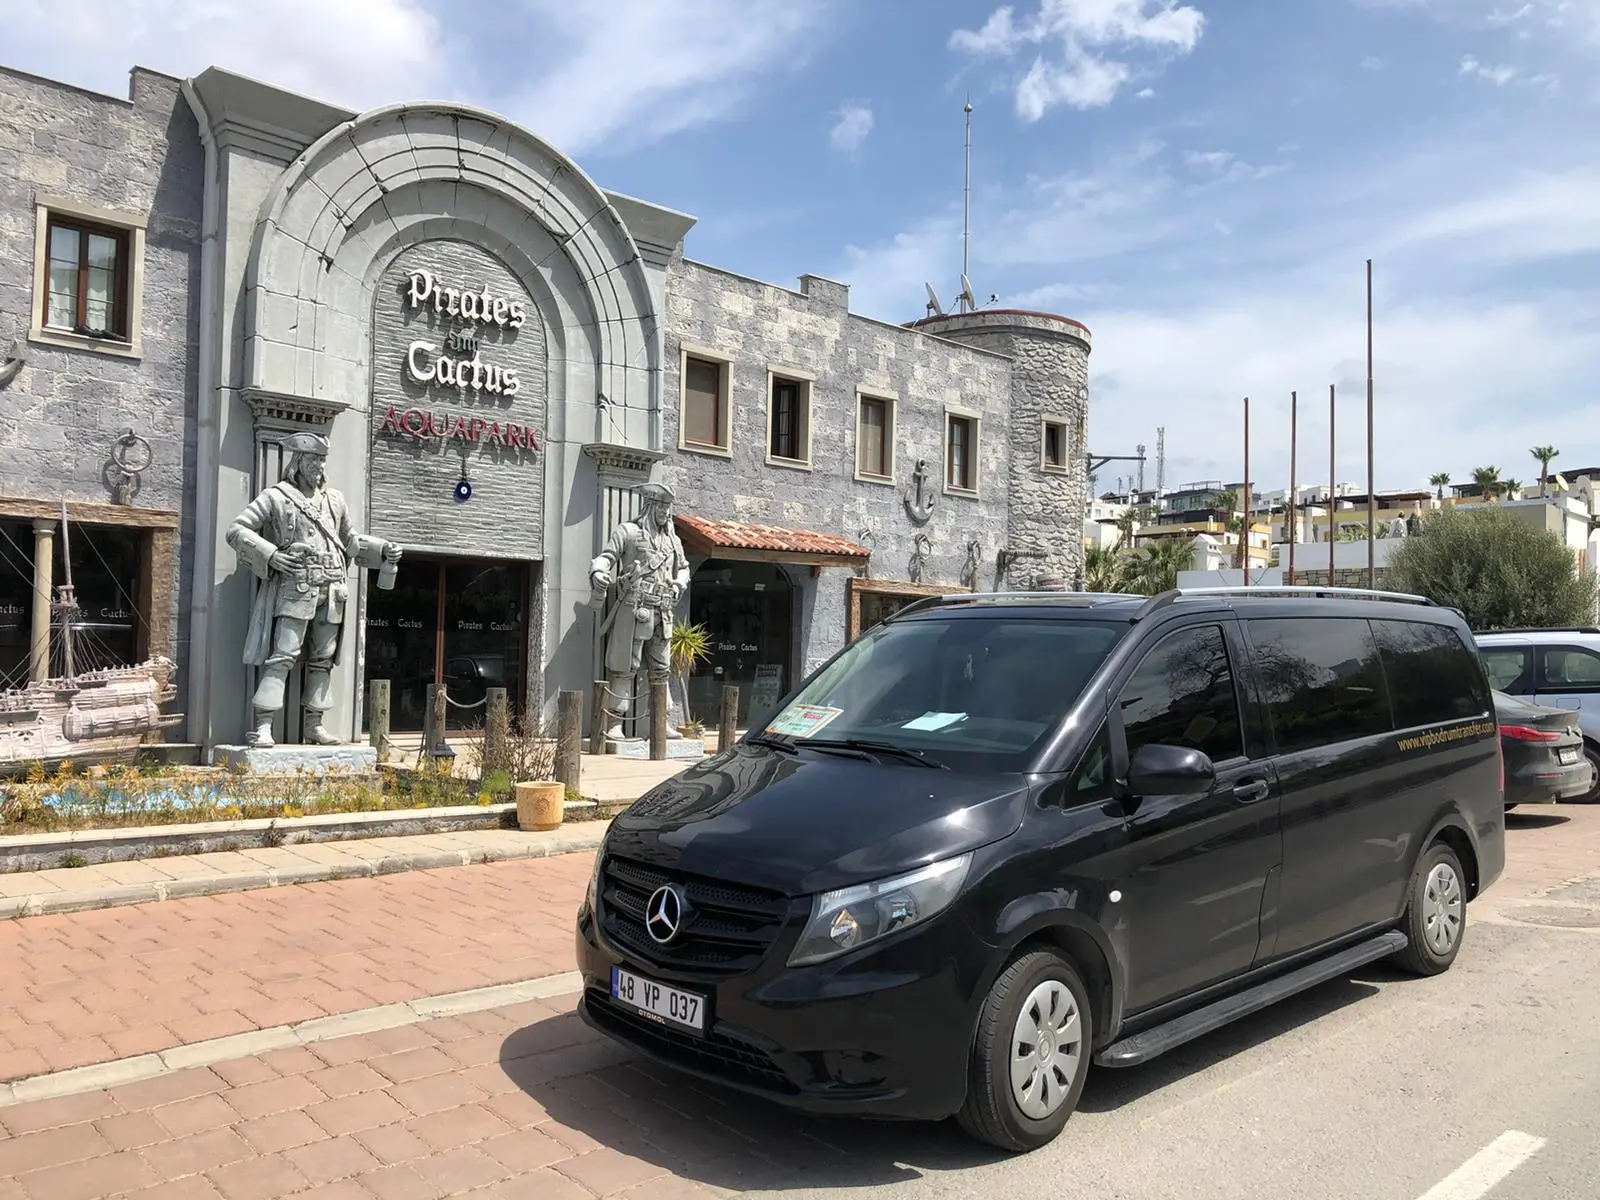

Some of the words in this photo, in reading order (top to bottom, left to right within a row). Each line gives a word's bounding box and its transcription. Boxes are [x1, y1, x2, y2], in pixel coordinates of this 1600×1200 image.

[403, 268, 526, 328] Pirates
[408, 340, 521, 395] Cactus
[380, 407, 543, 450] AQUAPARK
[0, 603, 25, 614] actus
[100, 607, 132, 618] Cactu
[365, 617, 389, 628] irates
[397, 618, 423, 629] Cactus
[458, 620, 483, 630] Pirates
[741, 643, 758, 652] Cactus
[620, 973, 635, 1001] 48
[644, 982, 660, 1010] VP
[669, 992, 699, 1023] 037
